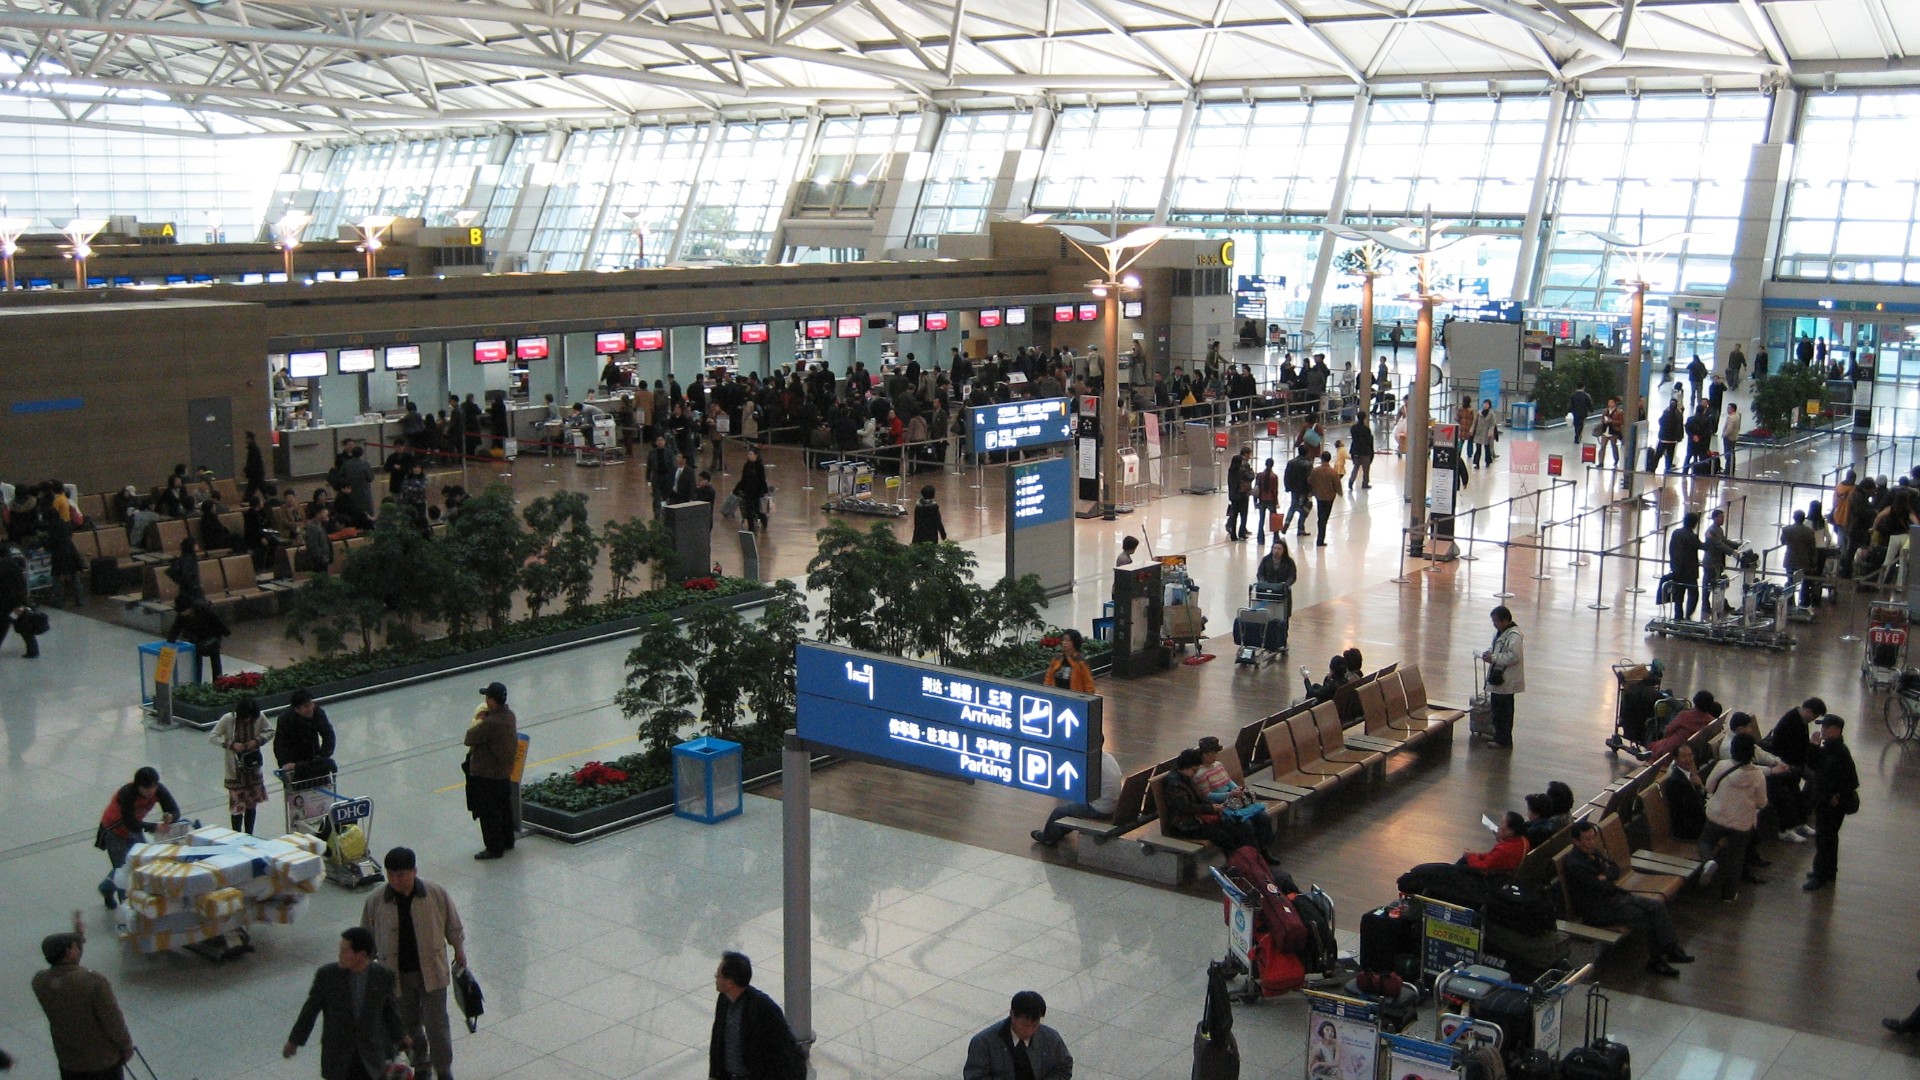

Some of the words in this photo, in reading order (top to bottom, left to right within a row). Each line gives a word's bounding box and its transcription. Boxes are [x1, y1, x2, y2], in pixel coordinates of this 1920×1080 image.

[162, 224, 174, 236] A
[470, 228, 482, 245] B
[1220, 241, 1234, 266] C
[1060, 402, 1067, 416] 1
[1875, 631, 1900, 644] BYC
[845, 661, 853, 680] 1
[960, 705, 1013, 730] Arrivals
[960, 755, 1013, 782] Parking
[337, 803, 367, 820] DHC
